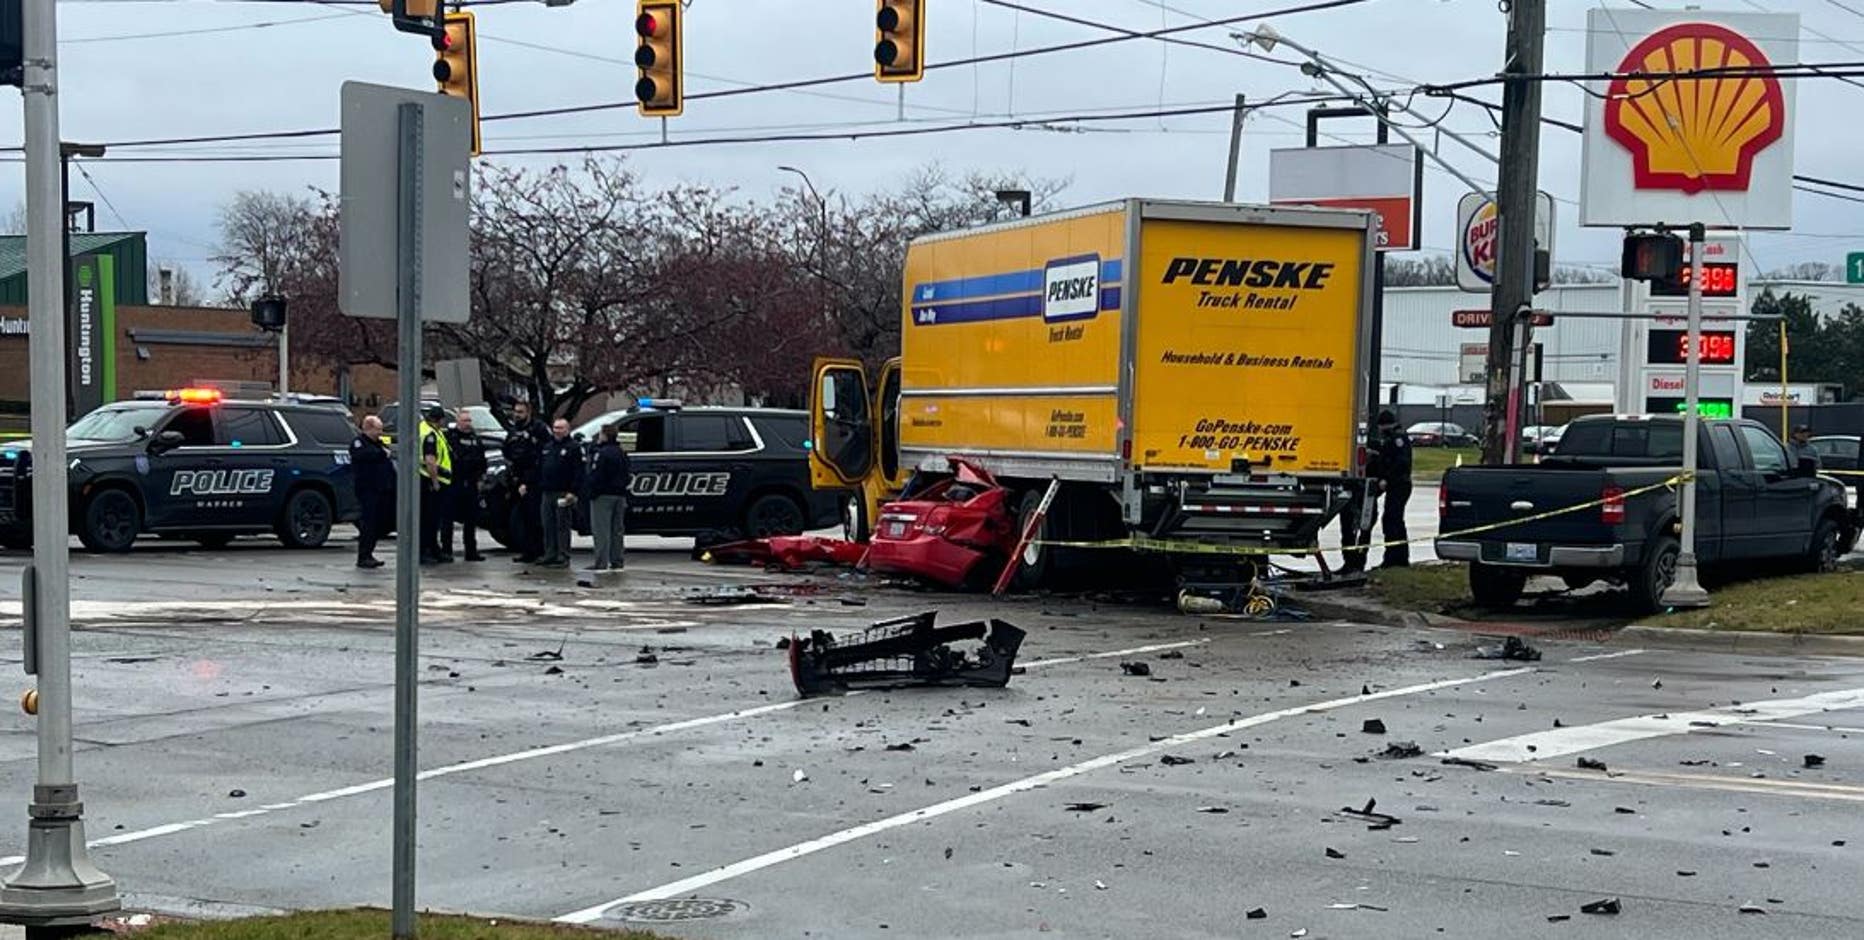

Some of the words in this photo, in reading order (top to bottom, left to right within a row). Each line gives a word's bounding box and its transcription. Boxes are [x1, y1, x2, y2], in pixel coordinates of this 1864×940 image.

[1471, 218, 1497, 243] BUR
[1473, 237, 1497, 266] KI
[1162, 257, 1335, 290] PENSKE
[1048, 275, 1095, 303] PENSKE
[1197, 291, 1240, 308] Truck
[1244, 292, 1299, 310] Rental
[0, 315, 30, 334] Hunti
[1456, 313, 1493, 325] DRIV
[78, 289, 93, 385] Huntington
[1161, 350, 1222, 366] Household
[1224, 354, 1235, 365] &
[1236, 353, 1290, 367] Business
[1290, 356, 1335, 369] Rentals
[1652, 378, 1685, 390] Diesel
[1195, 417, 1293, 435] GoPenske.com
[1178, 434, 1301, 451] 1-800-GO-PENSKE
[169, 469, 275, 496] POLICE
